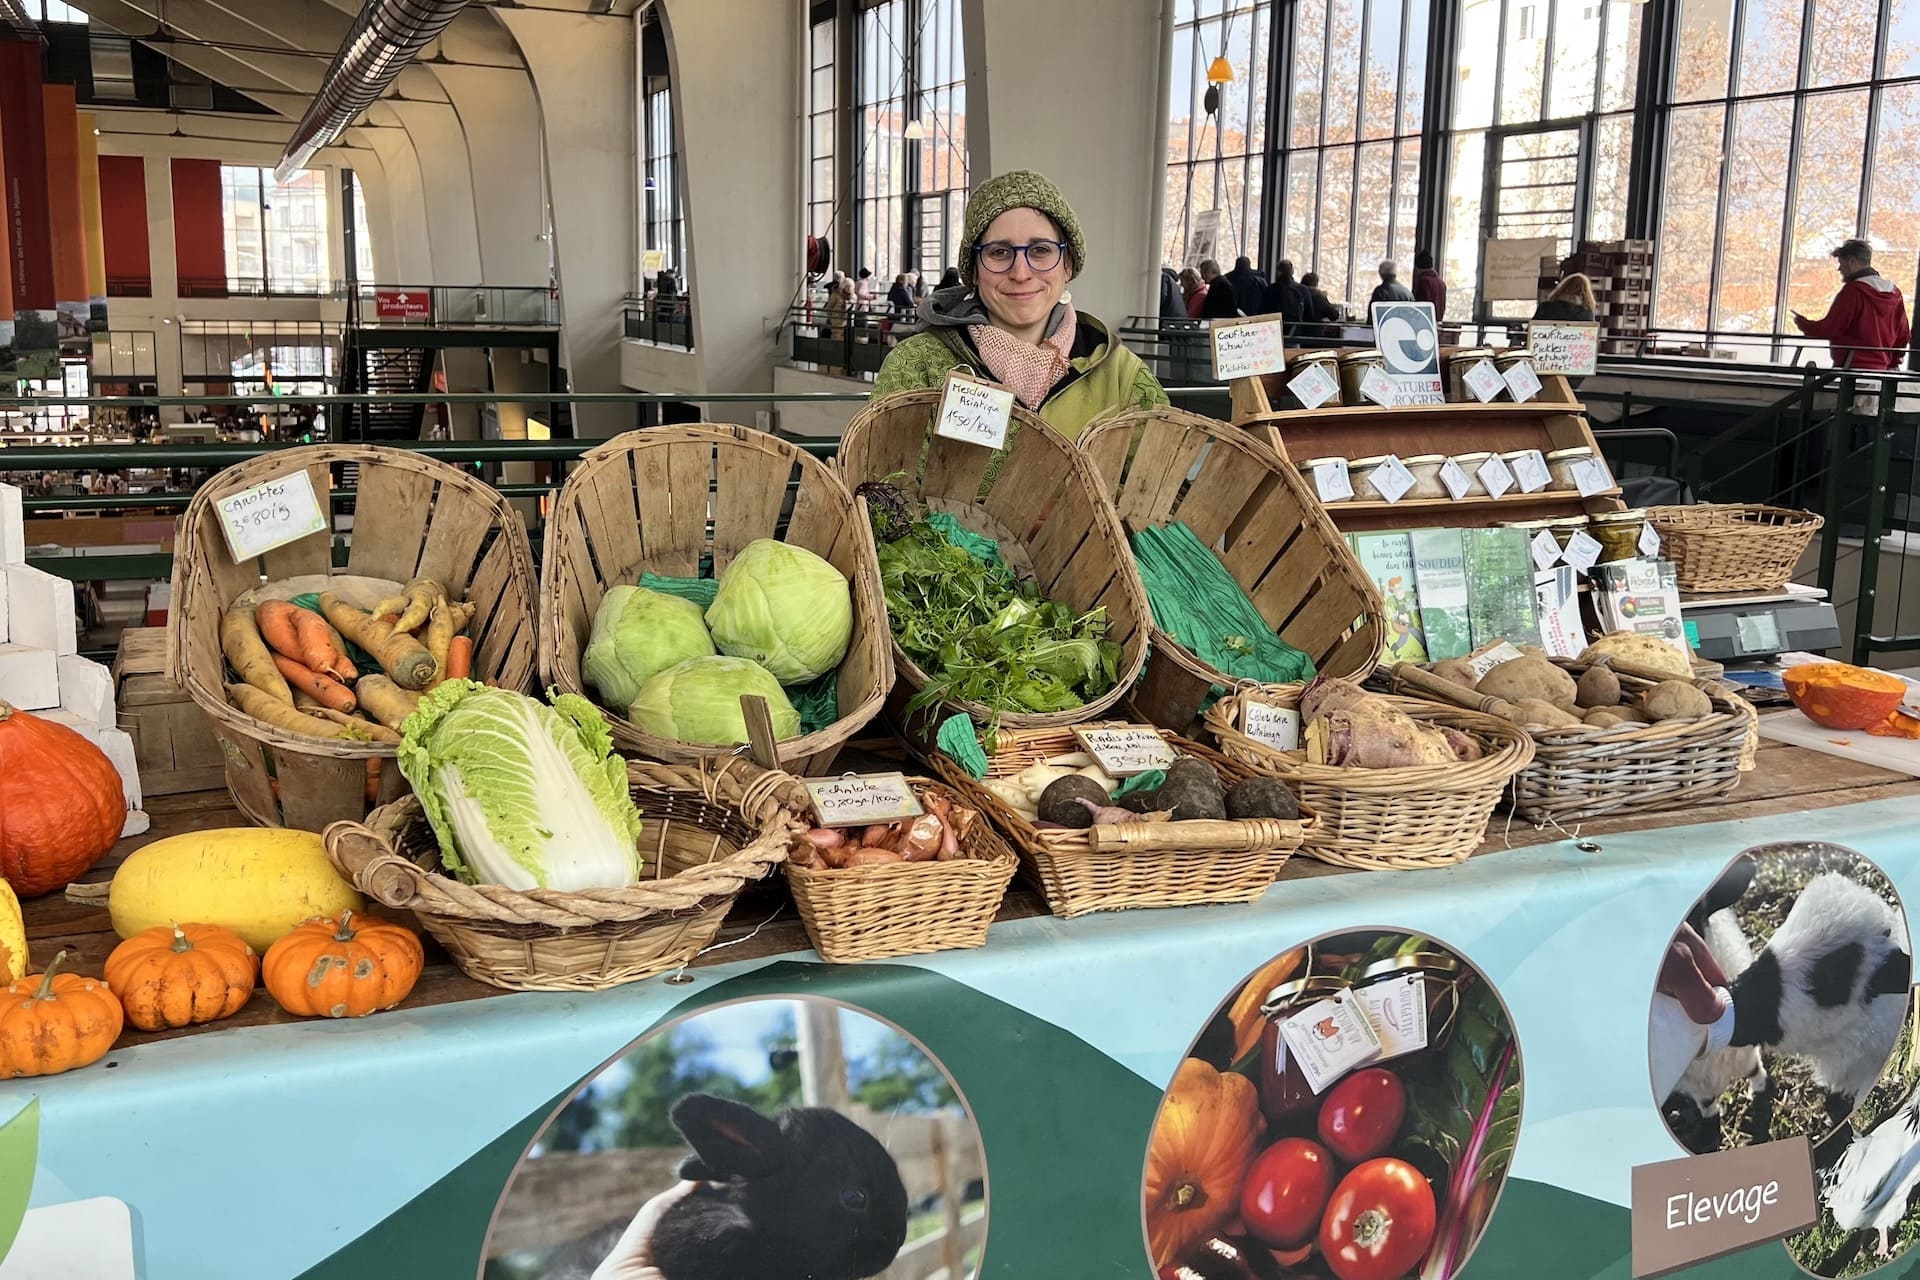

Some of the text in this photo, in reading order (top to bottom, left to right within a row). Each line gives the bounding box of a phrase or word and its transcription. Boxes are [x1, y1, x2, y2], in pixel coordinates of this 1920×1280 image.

[382, 301, 424, 310] producteurs
[1397, 381, 1432, 392] ATURE
[1393, 394, 1444, 406] ROGRES
[1666, 1180, 1779, 1230] Elevage
